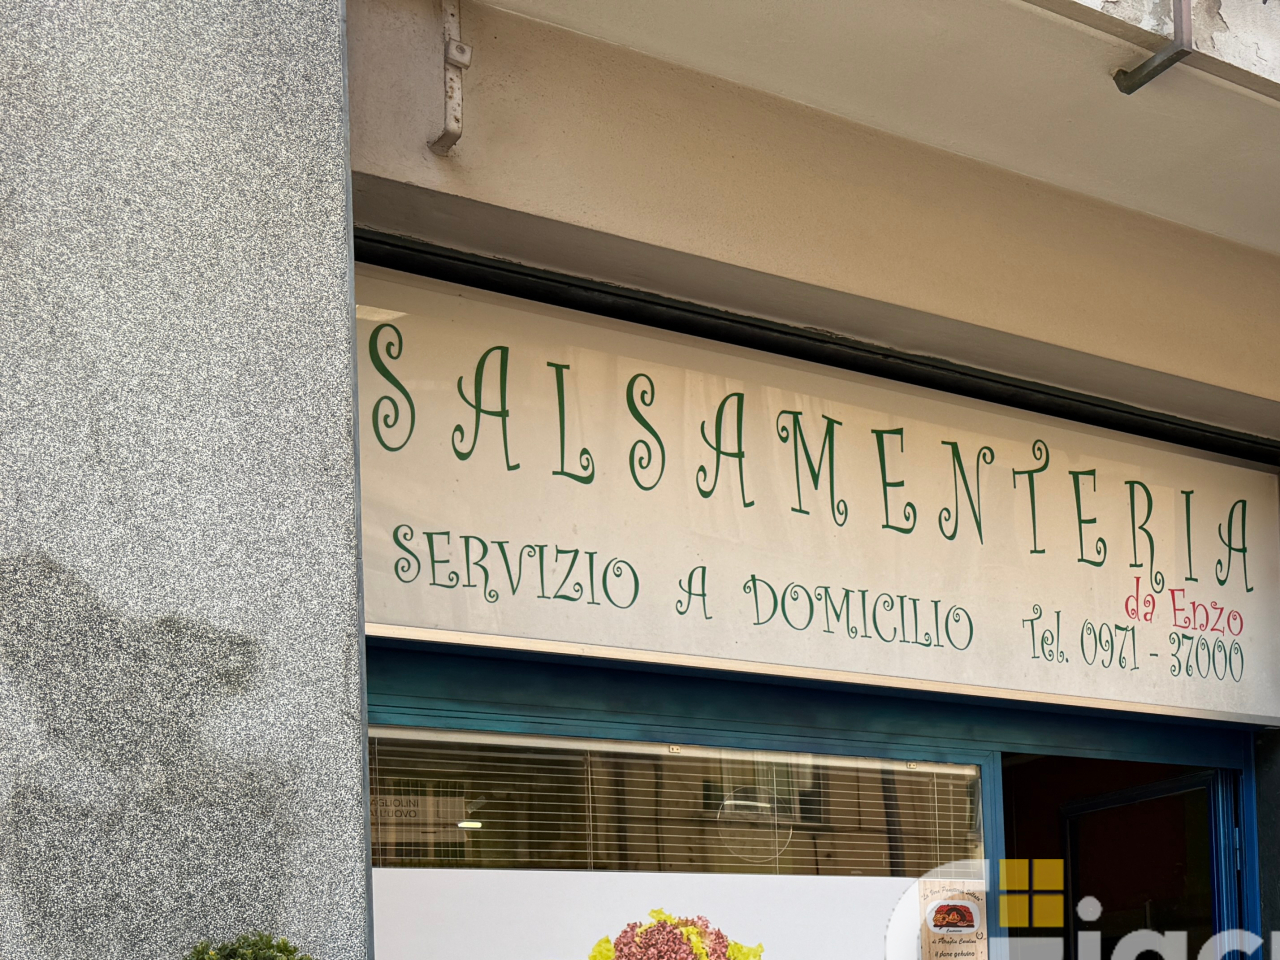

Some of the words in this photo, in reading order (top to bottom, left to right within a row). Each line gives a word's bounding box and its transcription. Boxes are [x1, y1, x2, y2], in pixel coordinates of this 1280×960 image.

[368, 322, 1254, 594] SALSAMENTERIA
[392, 524, 640, 609] SERVIZIO
[675, 565, 713, 620] A
[742, 573, 974, 651] DOMICILIO
[1124, 576, 1156, 624] da
[1168, 588, 1244, 637] Enzo
[1022, 603, 1069, 664] Tel.
[1080, 618, 1140, 672] 0971
[1169, 631, 1245, 683] 37000
